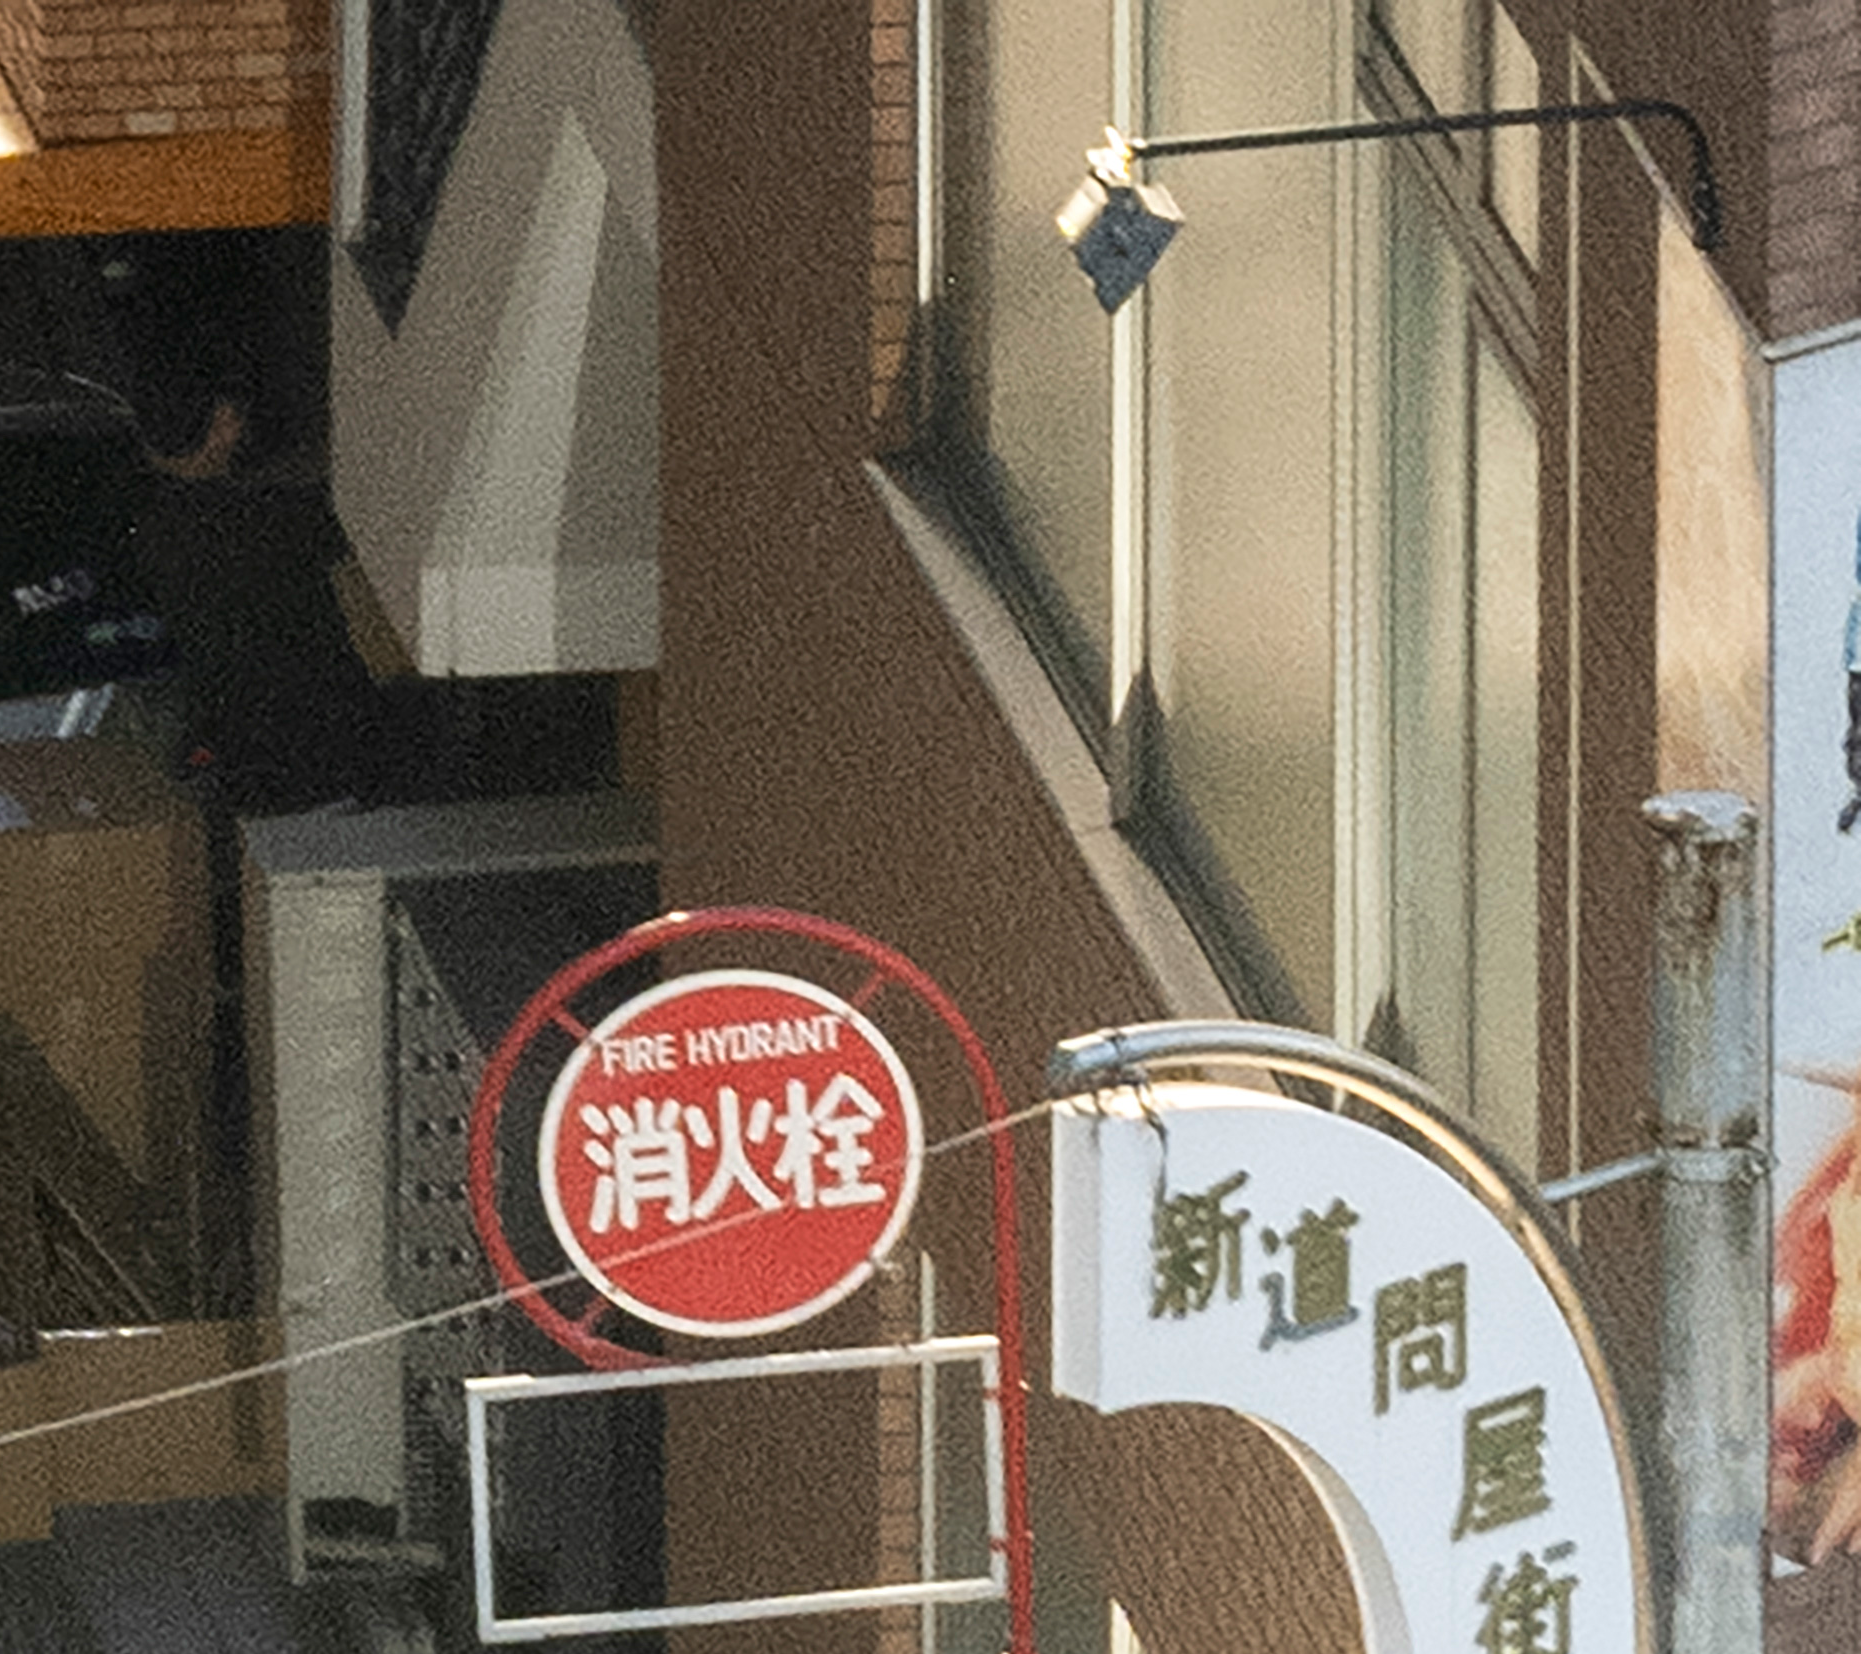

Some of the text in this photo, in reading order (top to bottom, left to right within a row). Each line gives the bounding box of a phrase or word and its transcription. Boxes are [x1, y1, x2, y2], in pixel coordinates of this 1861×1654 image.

[602, 1013, 843, 1077] FIRE HYDRANT
[579, 1071, 887, 1236] 消火栓
